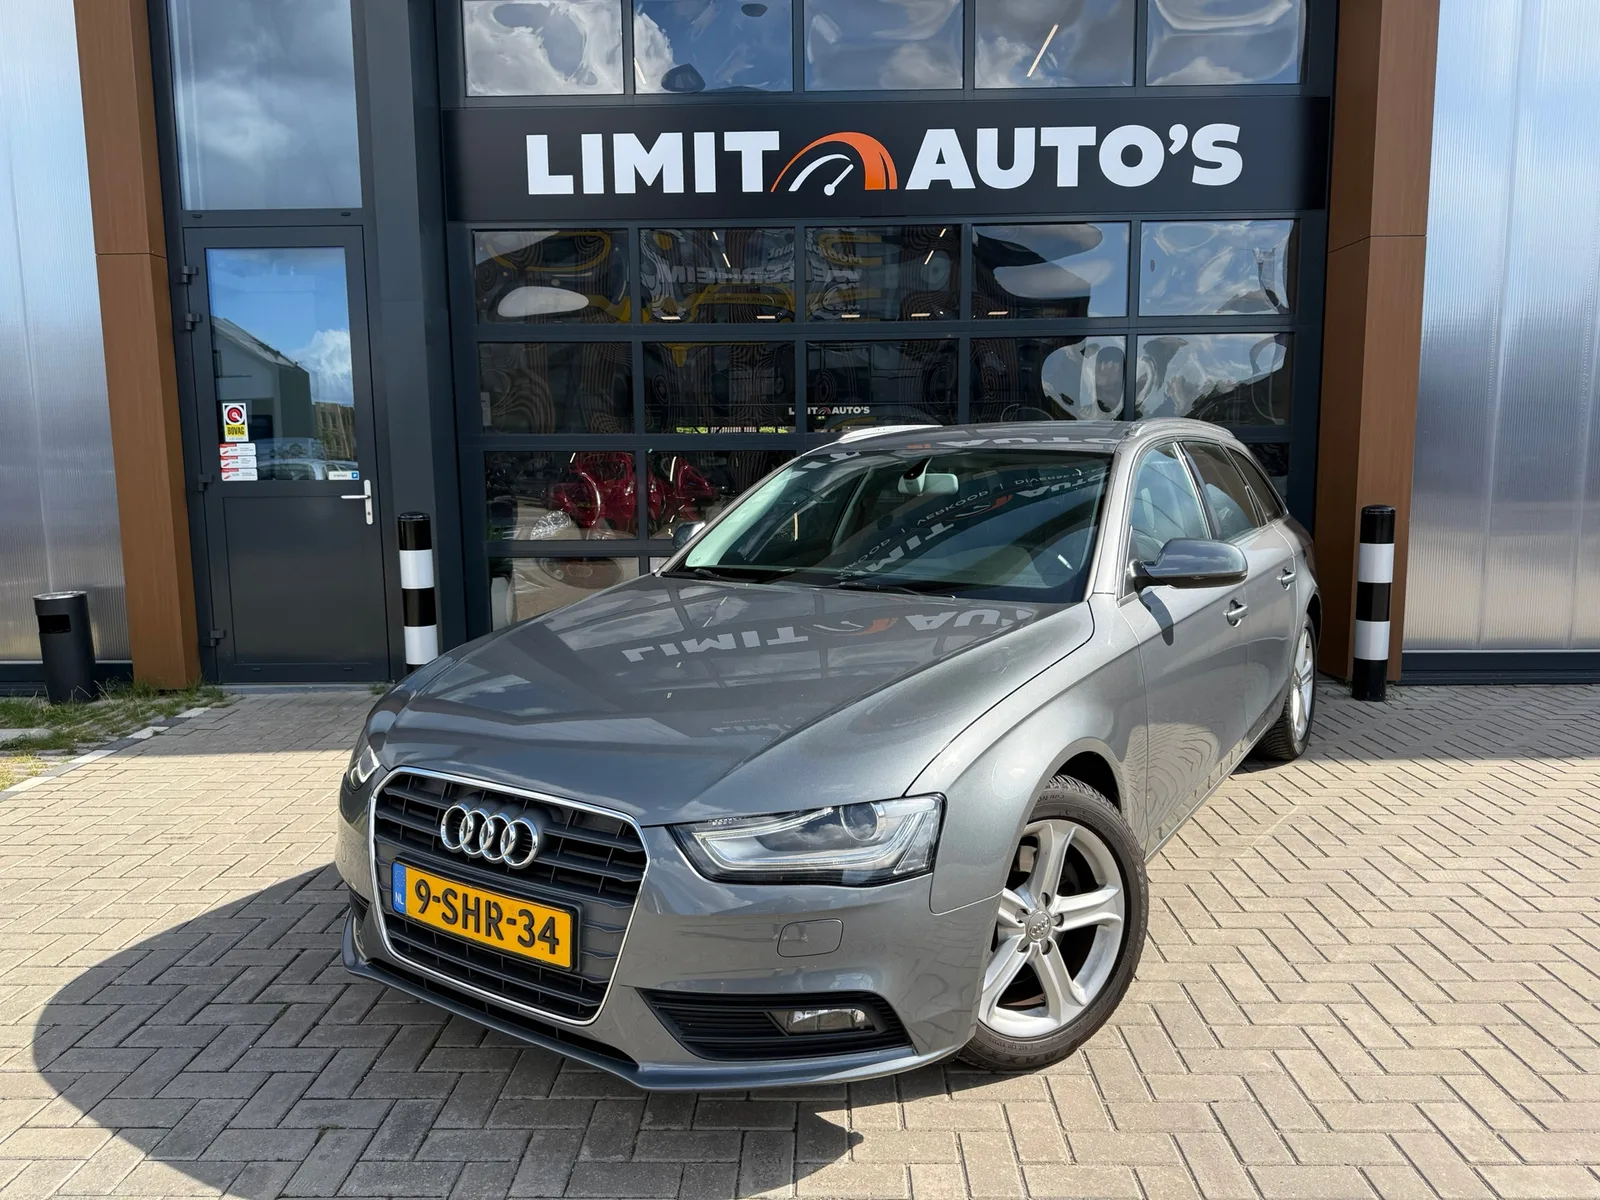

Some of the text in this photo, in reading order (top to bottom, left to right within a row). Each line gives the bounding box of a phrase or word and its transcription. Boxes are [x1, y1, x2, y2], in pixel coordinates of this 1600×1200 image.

[526, 123, 1243, 194] LIMIT AUTO'S
[227, 426, 245, 435] BOVAG
[788, 406, 870, 415] LIT AUTO'S
[394, 878, 560, 955] NL 9-SHR-34
